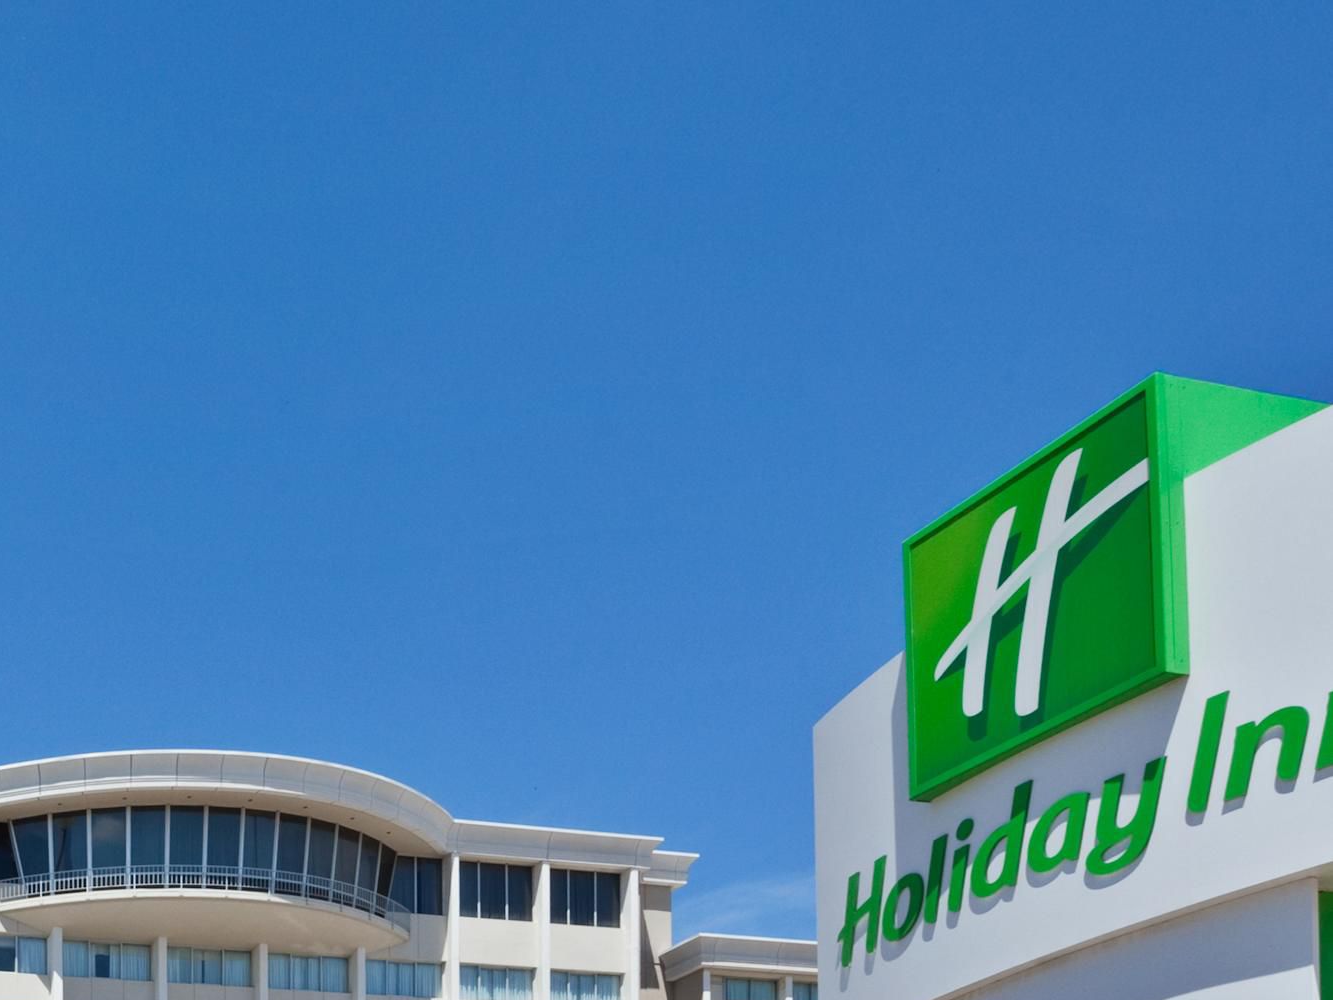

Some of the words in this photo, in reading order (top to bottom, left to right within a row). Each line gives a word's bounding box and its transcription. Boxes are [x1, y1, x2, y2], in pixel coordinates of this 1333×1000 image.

[934, 447, 1149, 717] H
[838, 756, 1167, 968] Holiday
[1187, 690, 1333, 813] In
